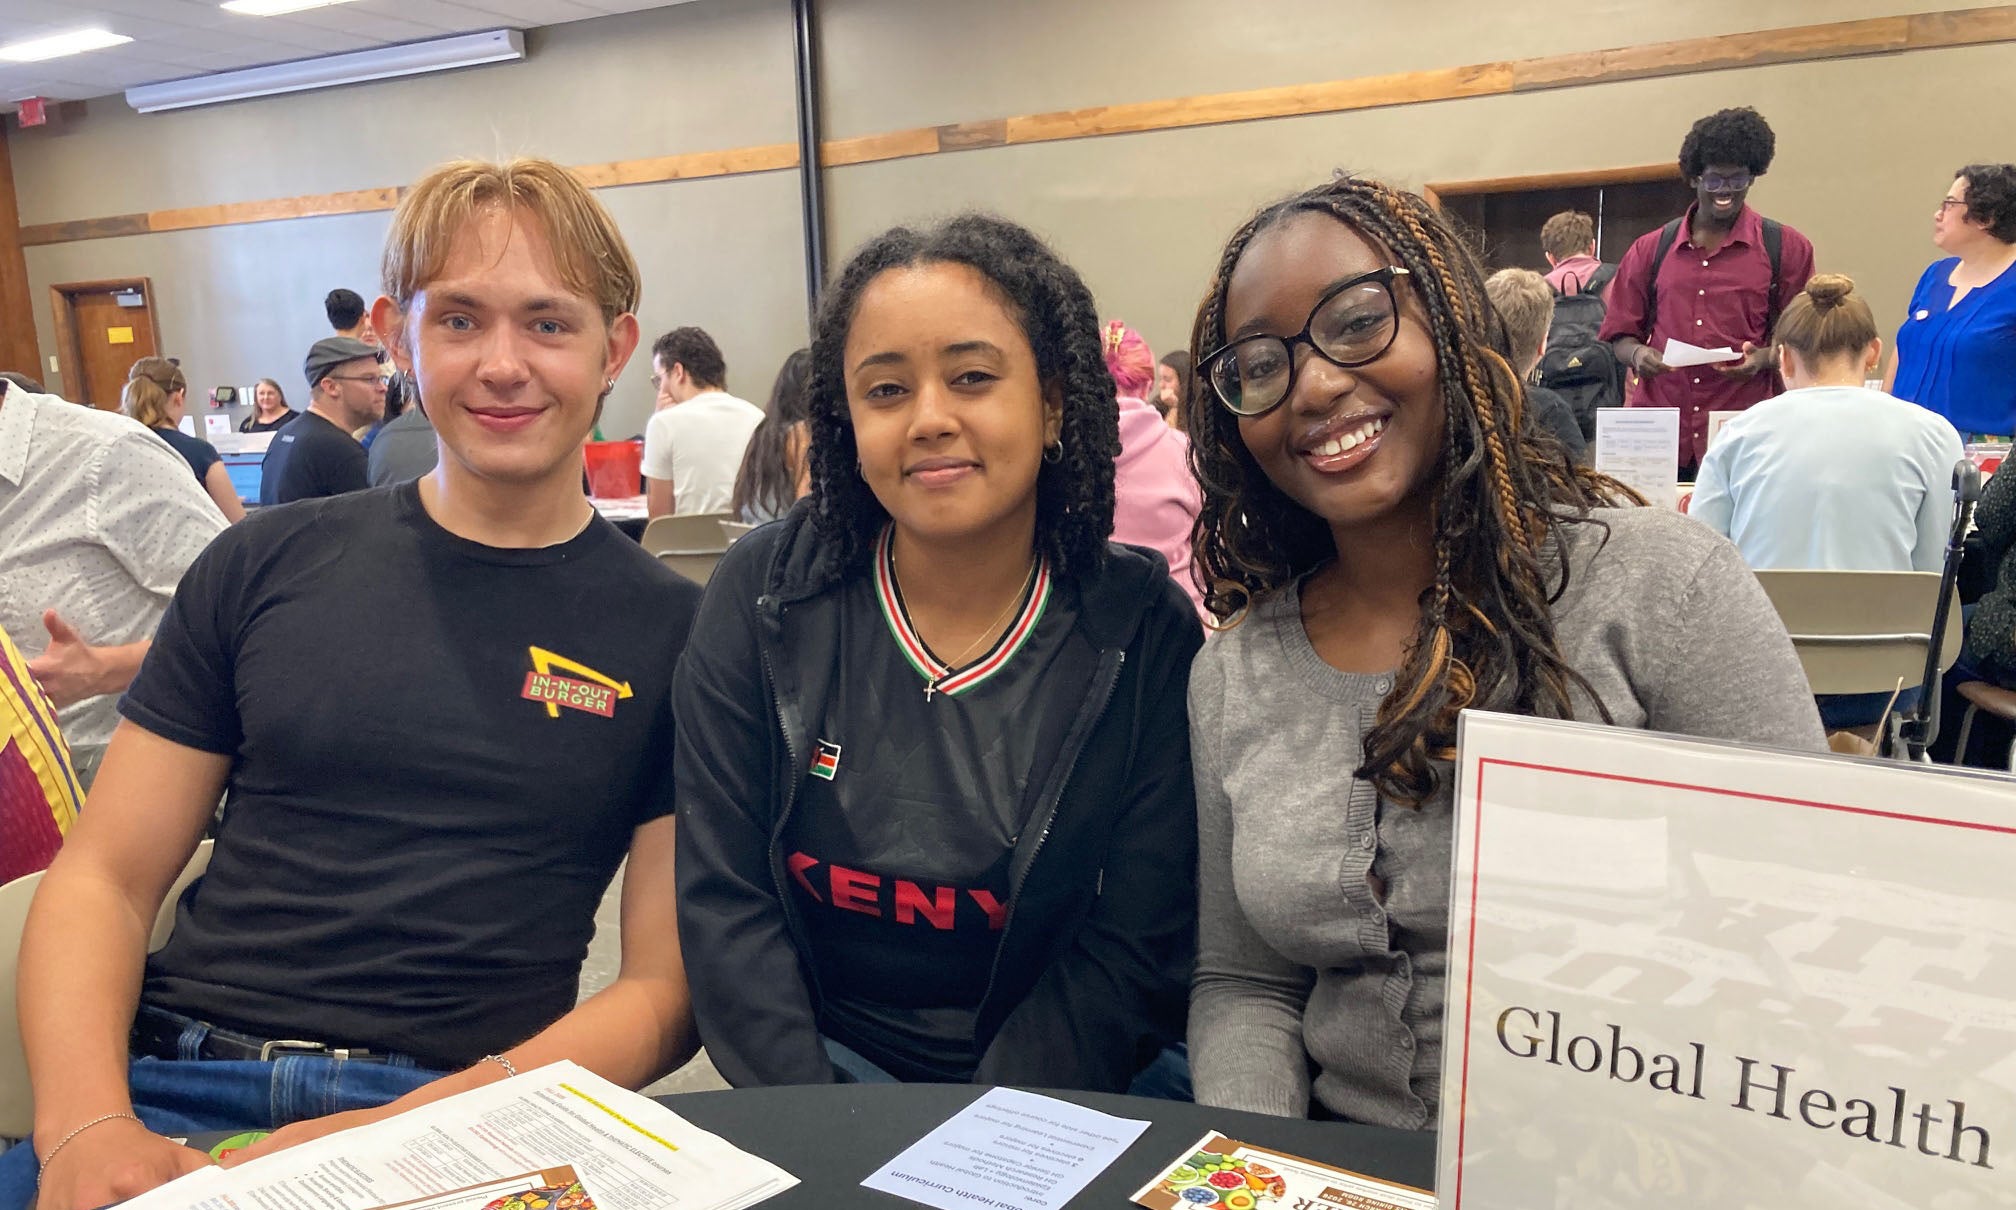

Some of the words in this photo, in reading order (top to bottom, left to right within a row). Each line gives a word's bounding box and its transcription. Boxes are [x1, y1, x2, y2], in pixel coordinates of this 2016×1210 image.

[533, 675, 611, 700] IN-N-OUT
[530, 686, 607, 712] BURGER
[1496, 1006, 1706, 1100] Global
[1731, 1056, 1995, 1170] Health
[971, 1150, 983, 1158] for
[929, 1160, 955, 1171] Health
[969, 1156, 1004, 1169] Methods
[955, 1168, 981, 1179] Global
[1006, 1167, 1044, 1181] Research
[1023, 1164, 1051, 1175] Senior
[891, 1171, 953, 1193] Curriculum
[956, 1190, 994, 1206] Health
[1341, 1192, 1365, 1202] ROOM
[1366, 1198, 1392, 1209] DINING
